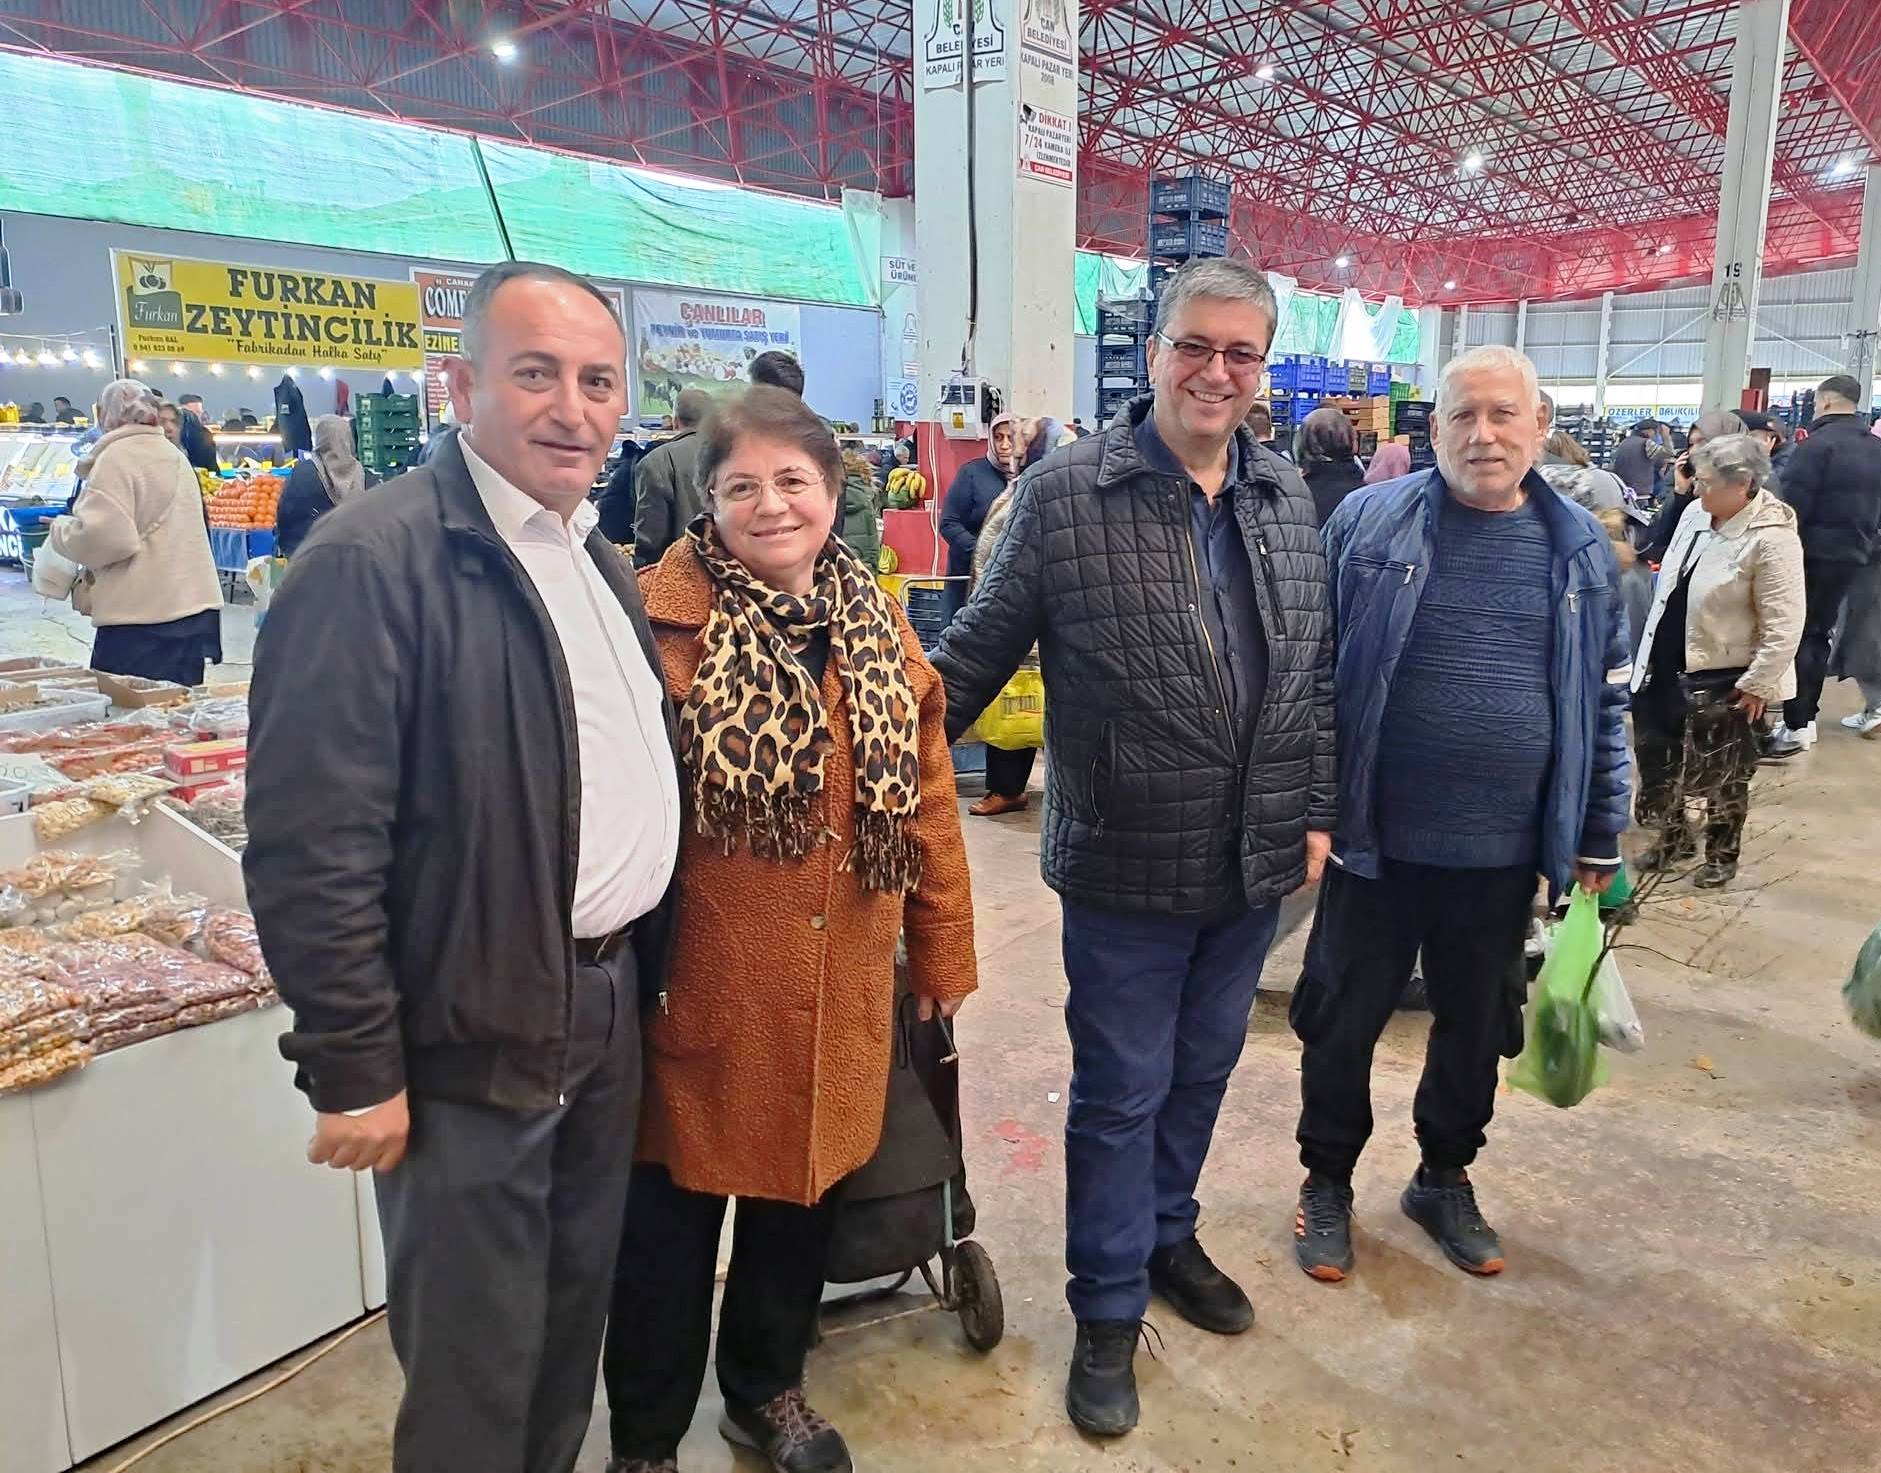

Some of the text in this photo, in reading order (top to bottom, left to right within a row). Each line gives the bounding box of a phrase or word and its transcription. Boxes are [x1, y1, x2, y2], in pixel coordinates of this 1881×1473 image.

[926, 62, 956, 76] KAPALI
[1025, 133, 1042, 149] 7/24
[227, 268, 376, 310] FURKAN
[134, 301, 178, 322] Furkan
[680, 302, 766, 328] ÇANLILAR
[185, 304, 418, 348] ZEYTİNCİLİK
[312, 345, 348, 359] Halka
[425, 332, 459, 353] EZİNE
